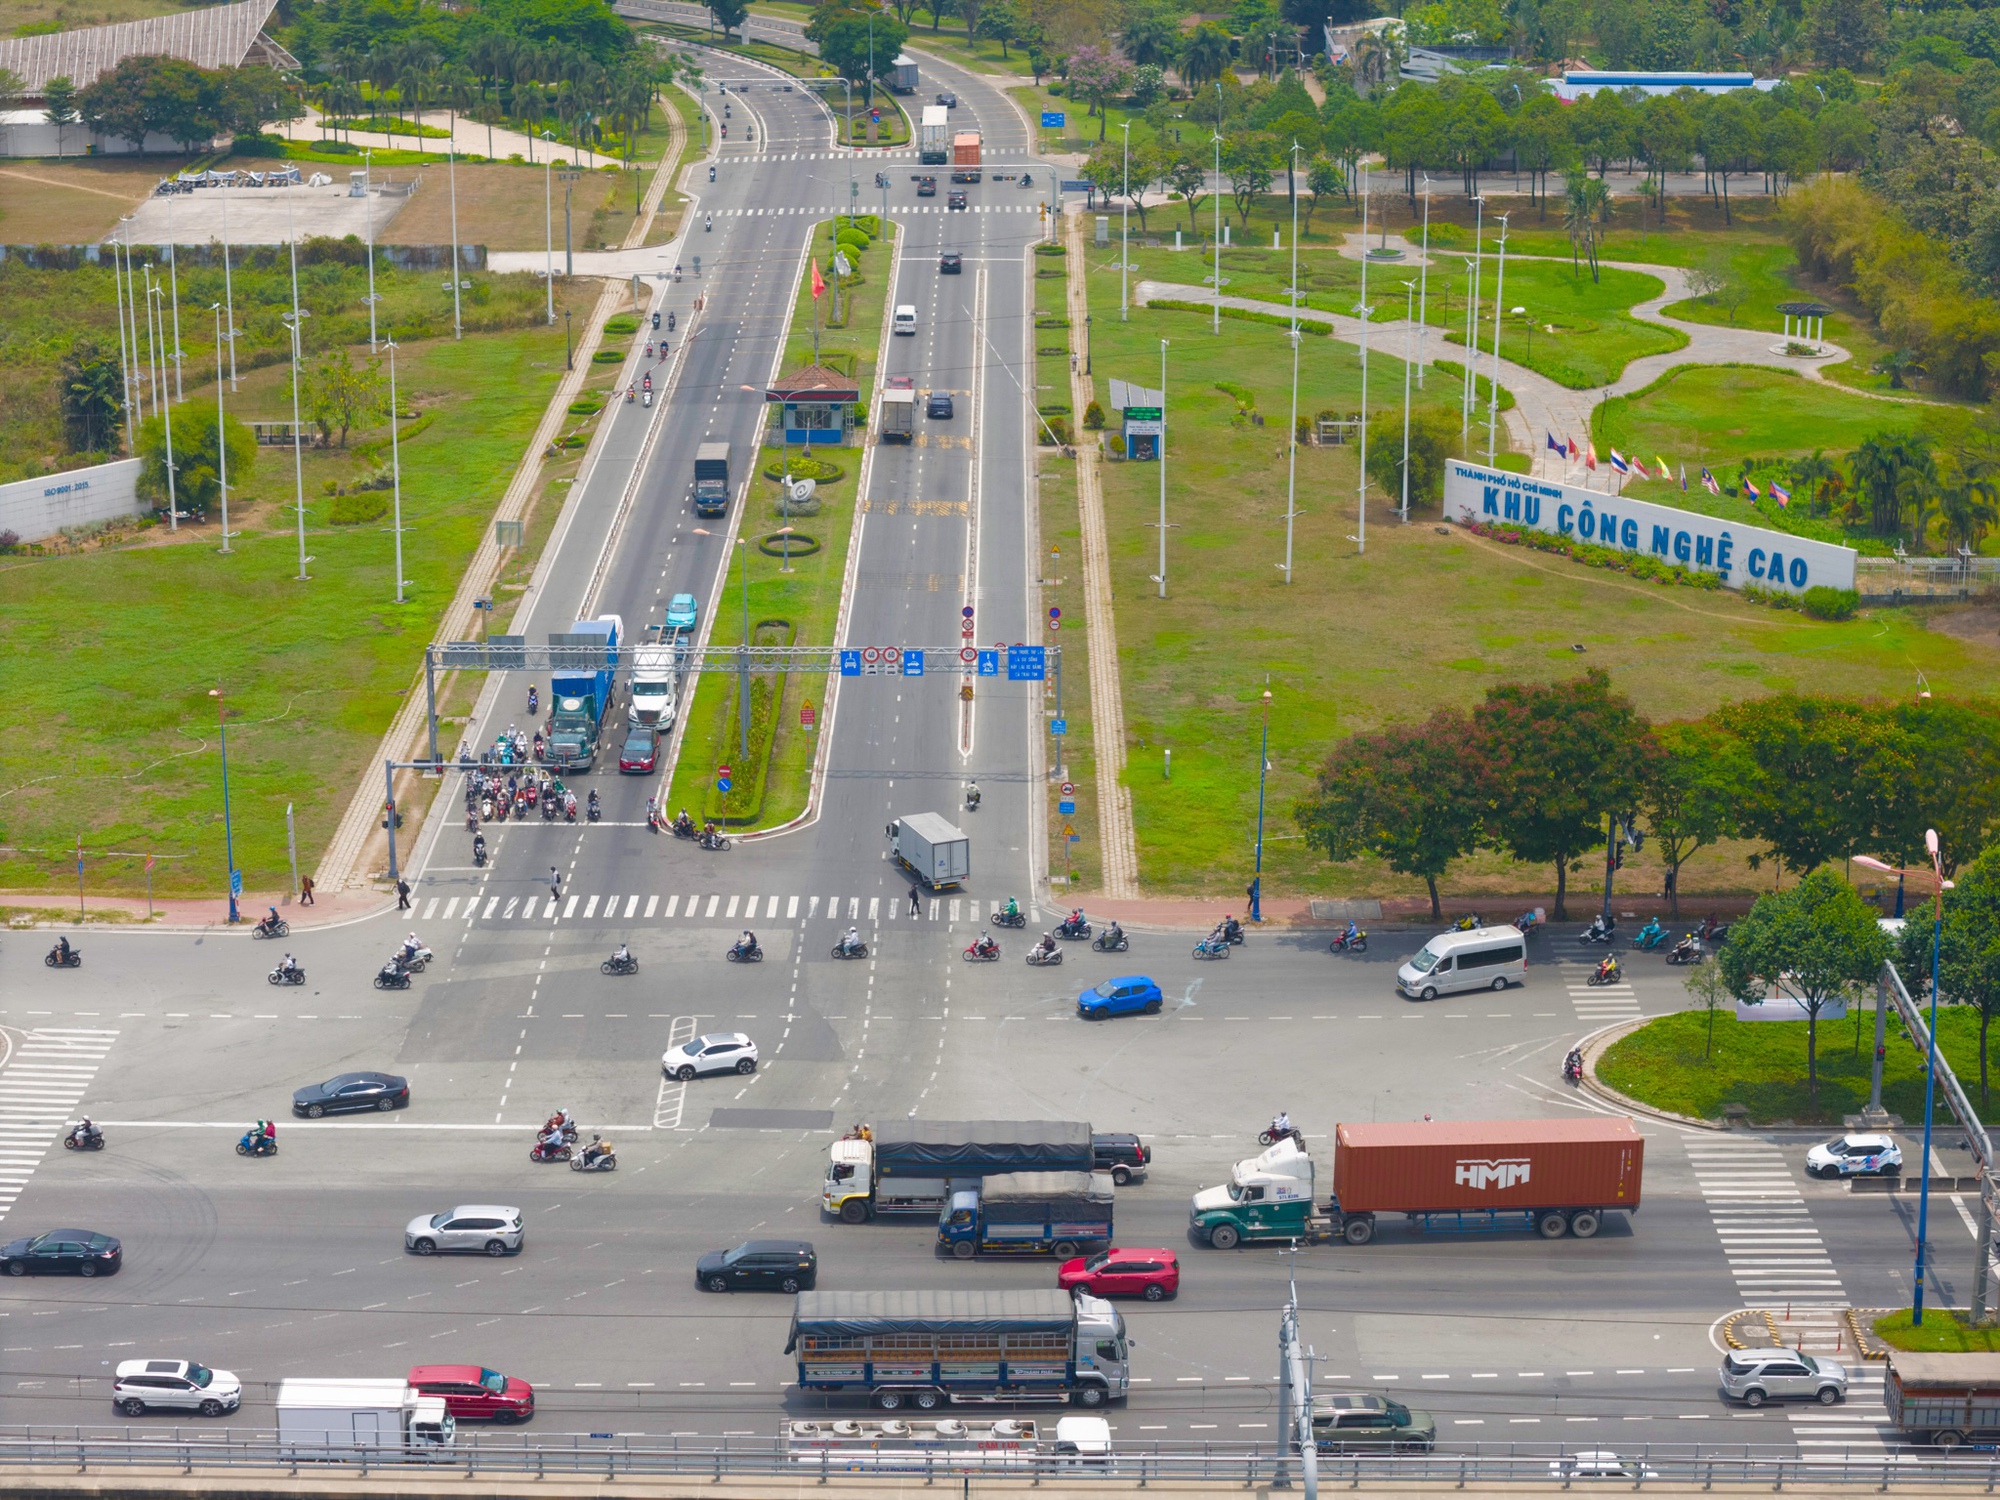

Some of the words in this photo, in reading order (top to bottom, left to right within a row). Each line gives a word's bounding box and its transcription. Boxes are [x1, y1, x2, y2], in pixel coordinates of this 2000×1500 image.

[44, 487, 56, 497] ISO
[1455, 467, 1486, 482] THÀNH
[1488, 474, 1507, 486] PHỐ
[1508, 476, 1521, 489] HỒ
[1522, 482, 1538, 493] CHÍ
[1539, 486, 1562, 499] MINH
[1483, 486, 1540, 525] KHU
[1557, 500, 1638, 549] CÔNG
[1652, 524, 1733, 580] NGHỆ
[1748, 548, 1808, 588] CAO
[1455, 1163, 1531, 1190] HMM
[977, 1440, 998, 1449] CẤM
